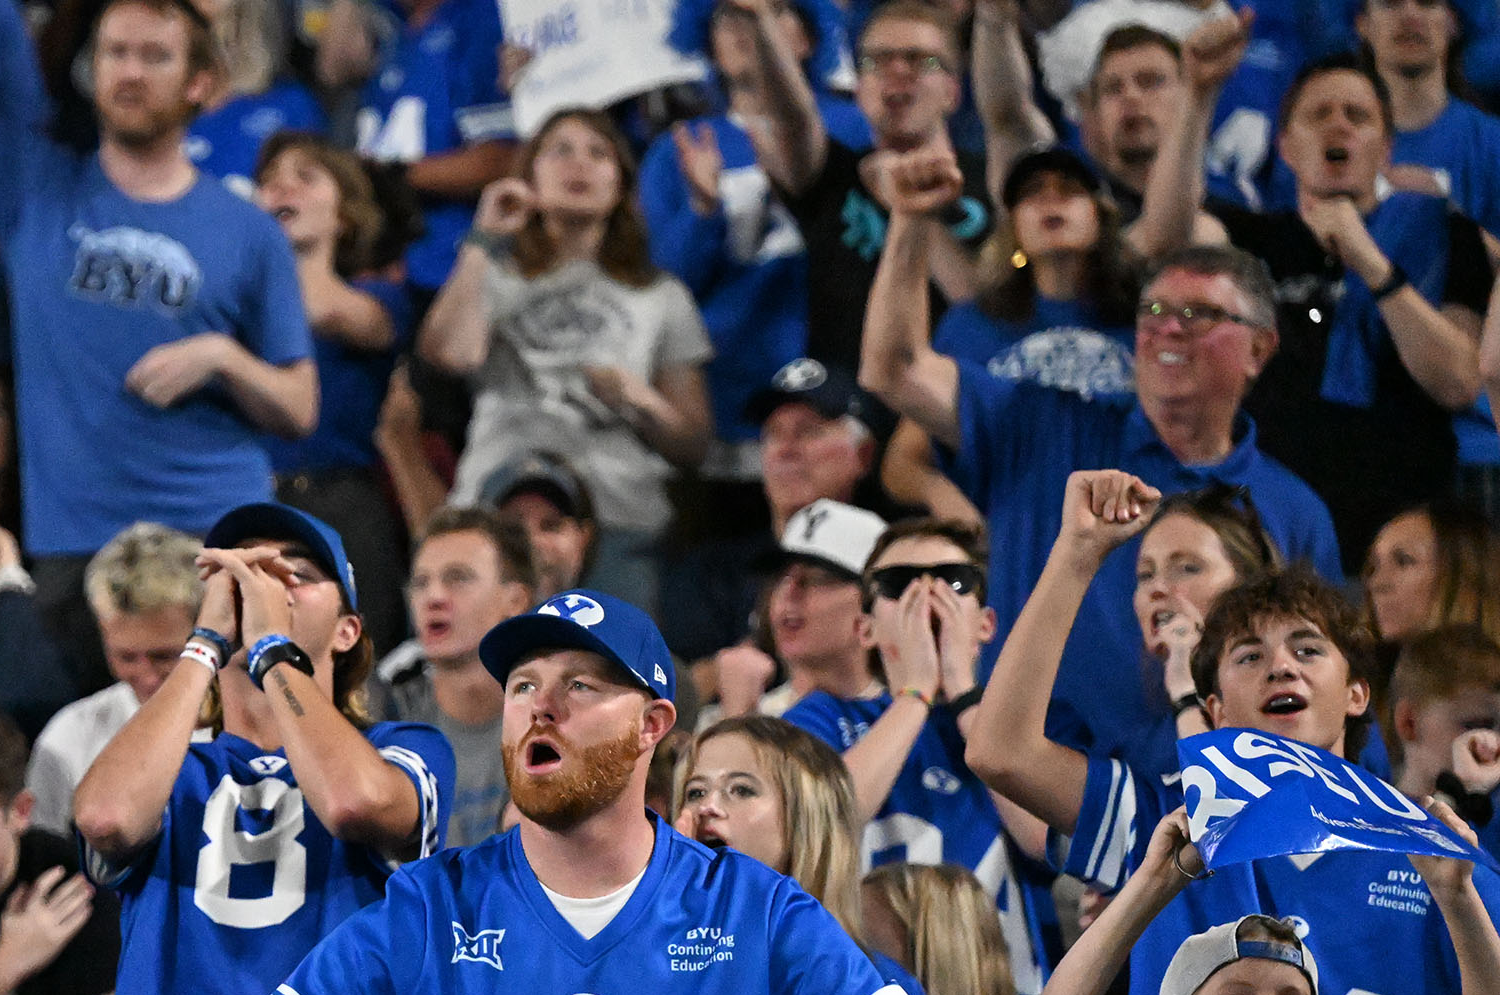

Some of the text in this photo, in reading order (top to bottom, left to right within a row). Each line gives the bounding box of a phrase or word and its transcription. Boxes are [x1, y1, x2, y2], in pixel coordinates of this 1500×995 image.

[73, 250, 196, 312] BYU
[1181, 731, 1360, 843] RISE
[1310, 804, 1410, 837] AdventH
[193, 773, 306, 930] 8
[1386, 869, 1422, 885] BYU
[1367, 882, 1431, 906] Continuing
[1367, 893, 1427, 916] Education
[666, 934, 735, 957] Continng
[686, 926, 722, 941] BYU
